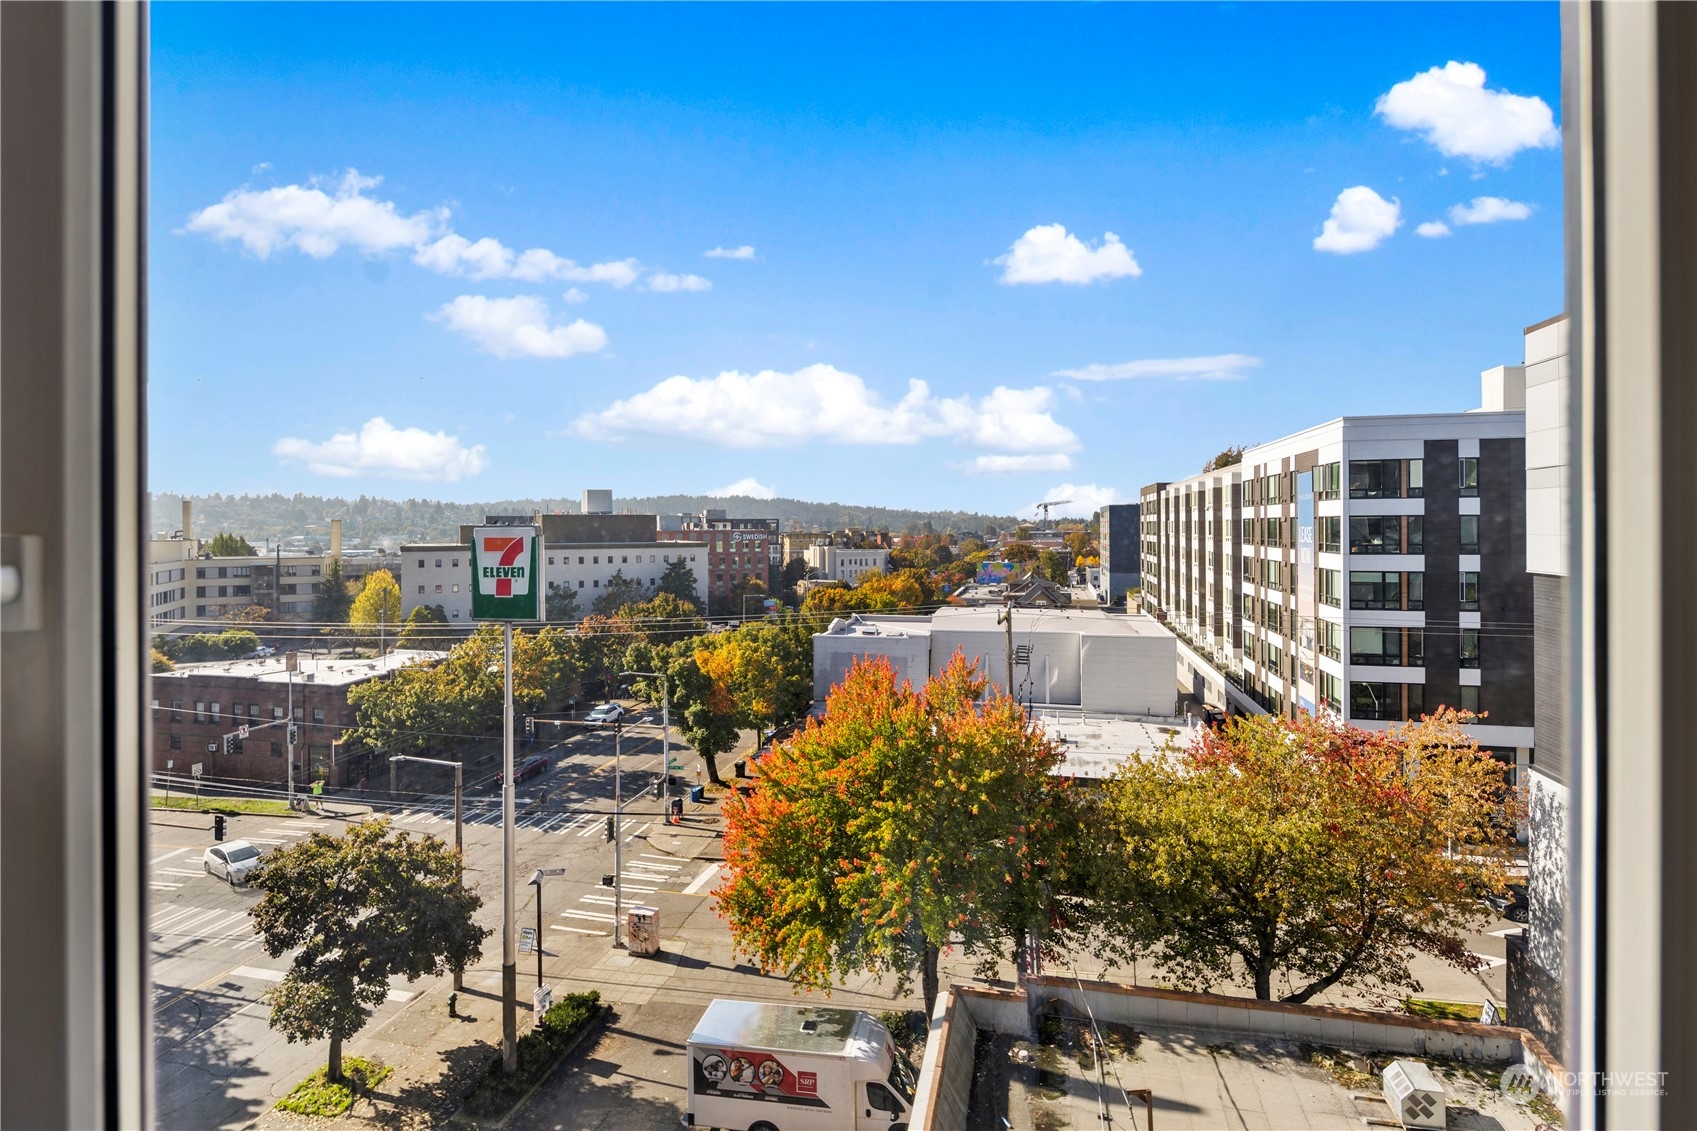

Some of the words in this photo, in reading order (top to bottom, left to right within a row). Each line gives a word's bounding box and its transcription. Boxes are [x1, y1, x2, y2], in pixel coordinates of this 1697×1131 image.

[1299, 526, 1313, 543] LEASE
[483, 536, 524, 596] 7
[800, 1078, 815, 1086] SRP
